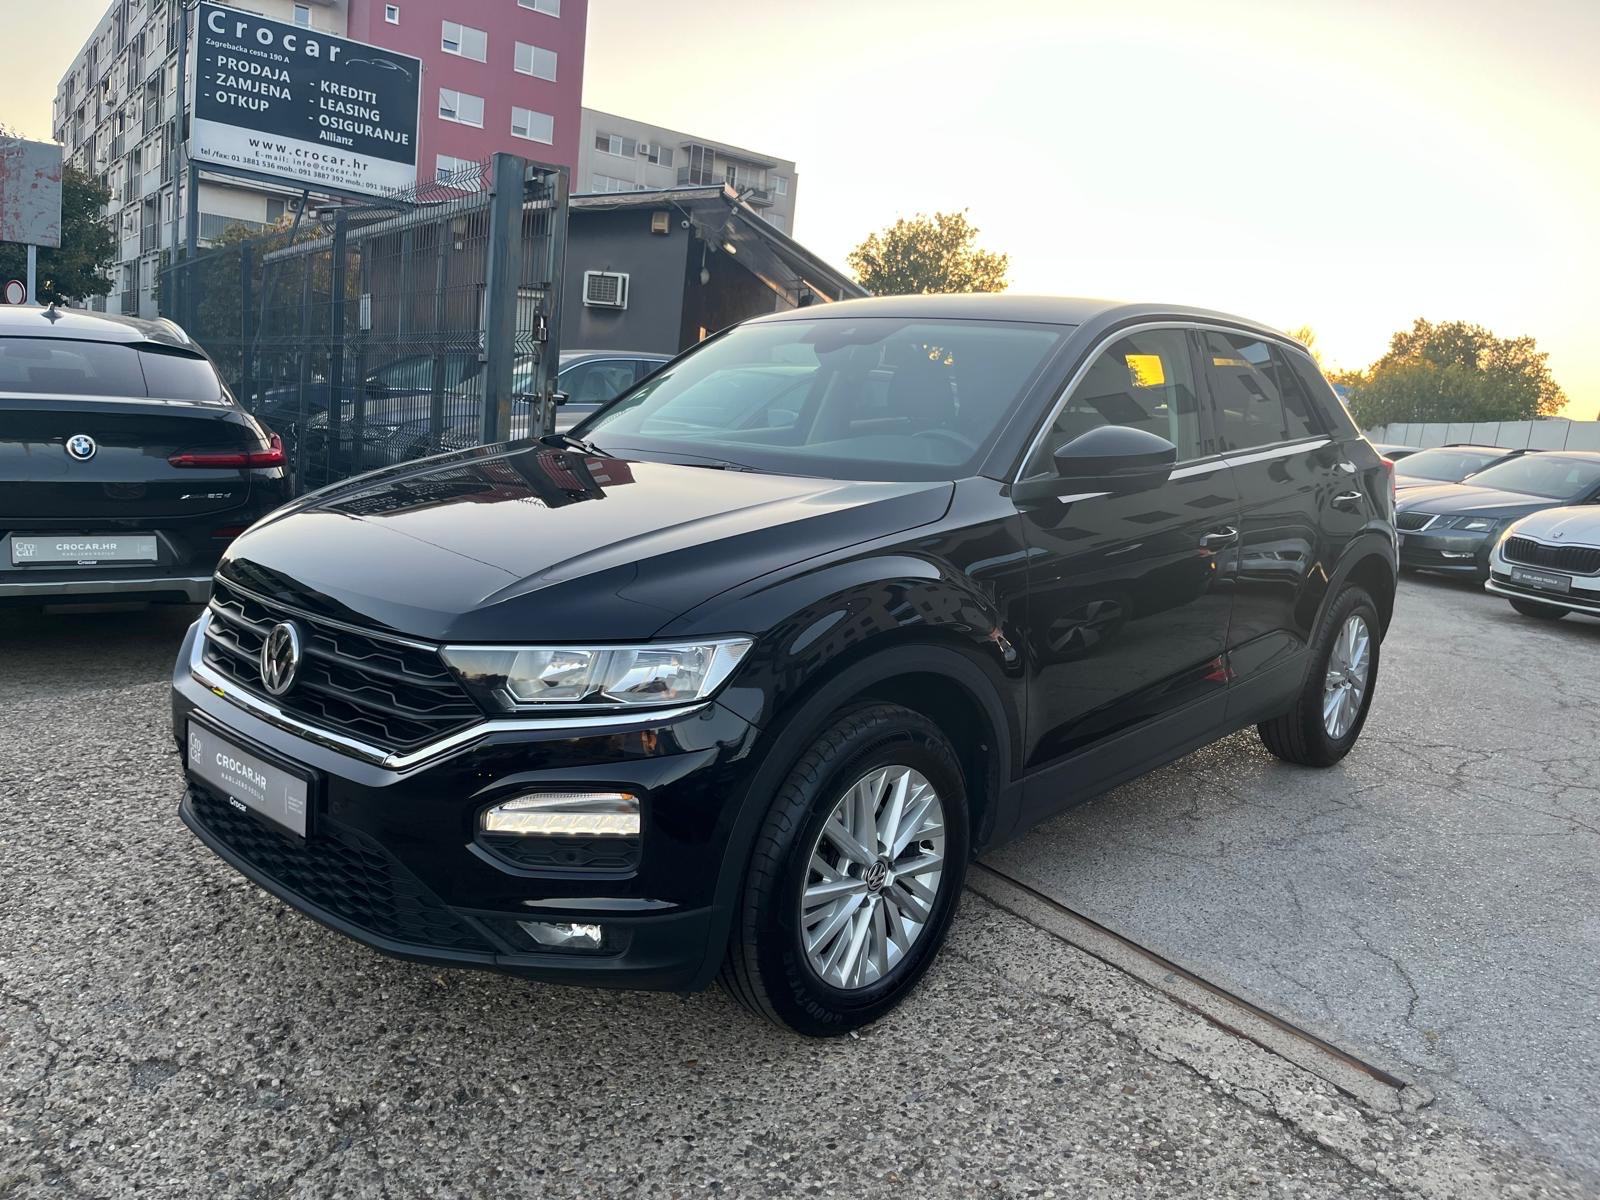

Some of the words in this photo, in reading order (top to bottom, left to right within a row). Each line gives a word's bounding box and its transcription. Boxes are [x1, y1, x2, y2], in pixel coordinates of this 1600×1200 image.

[207, 10, 341, 62] Crocar
[217, 55, 290, 83] PRODAJA
[249, 49, 267, 58] cesta
[269, 52, 283, 62] 190
[283, 56, 290, 64] A
[216, 72, 291, 101] ZAMJENA
[320, 79, 376, 105] KREDITI
[215, 90, 269, 112] OTKUP
[319, 97, 380, 122] LEASING
[319, 114, 409, 146] OSIGURANJE
[319, 130, 354, 146] Allianz
[249, 138, 368, 171] www.crocar.hr
[292, 158, 362, 178] info@crocar.hr
[231, 154, 240, 162] 01
[243, 157, 260, 166] 3881
[262, 160, 275, 169] 536
[298, 168, 311, 176] 091
[332, 175, 344, 183] 392
[216, 752, 267, 790] CROCAR.HR
[229, 796, 247, 812] Crocar
